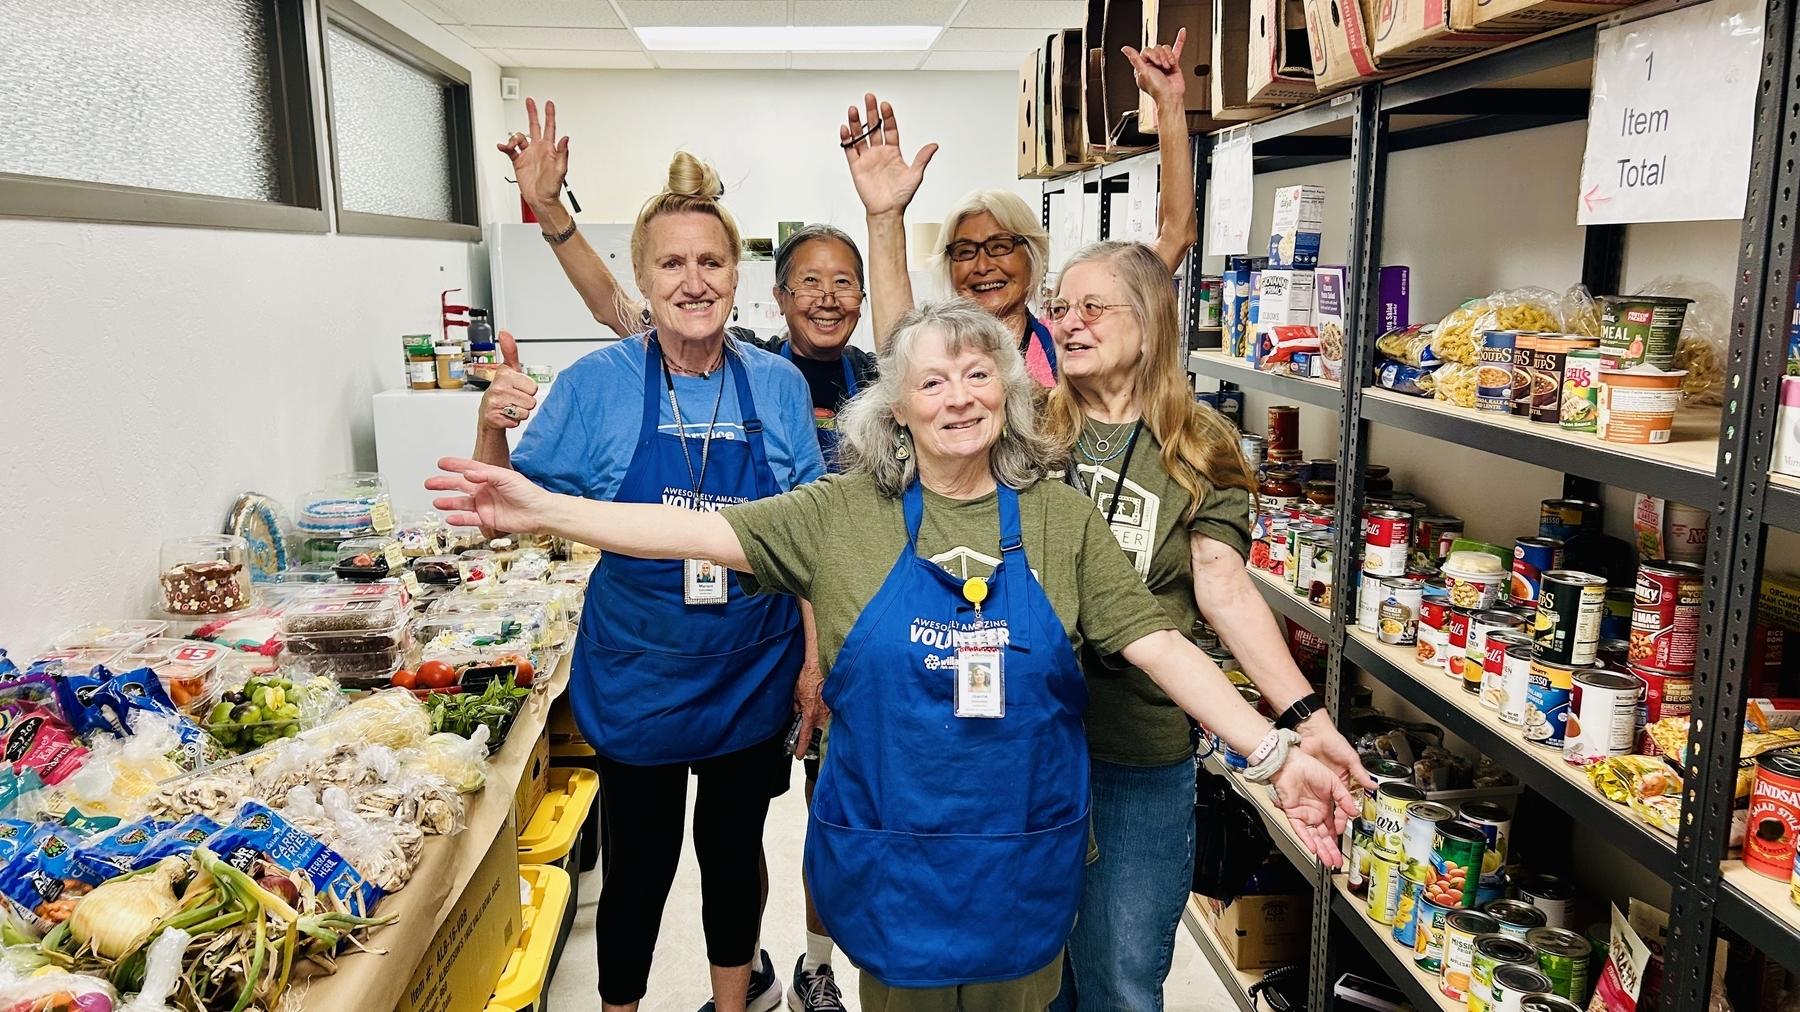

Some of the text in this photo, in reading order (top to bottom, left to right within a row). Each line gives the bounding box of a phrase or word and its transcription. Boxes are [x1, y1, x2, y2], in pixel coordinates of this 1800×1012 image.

[1645, 51, 1654, 81] 1
[1621, 107, 1669, 137] Item
[1617, 155, 1667, 189] Total
[1385, 303, 1393, 321] Salad
[715, 494, 749, 504] AMAZING
[913, 617, 960, 632] AWESOLY
[1639, 611, 1660, 625] MAC
[37, 741, 60, 761] Kale
[1752, 802, 1800, 831] SALAD STYLE
[272, 827, 301, 859] CARRO
[283, 832, 310, 862] FRIES
[231, 846, 249, 867] AIR
[318, 860, 338, 878] HERB
[410, 979, 425, 1007] Item
